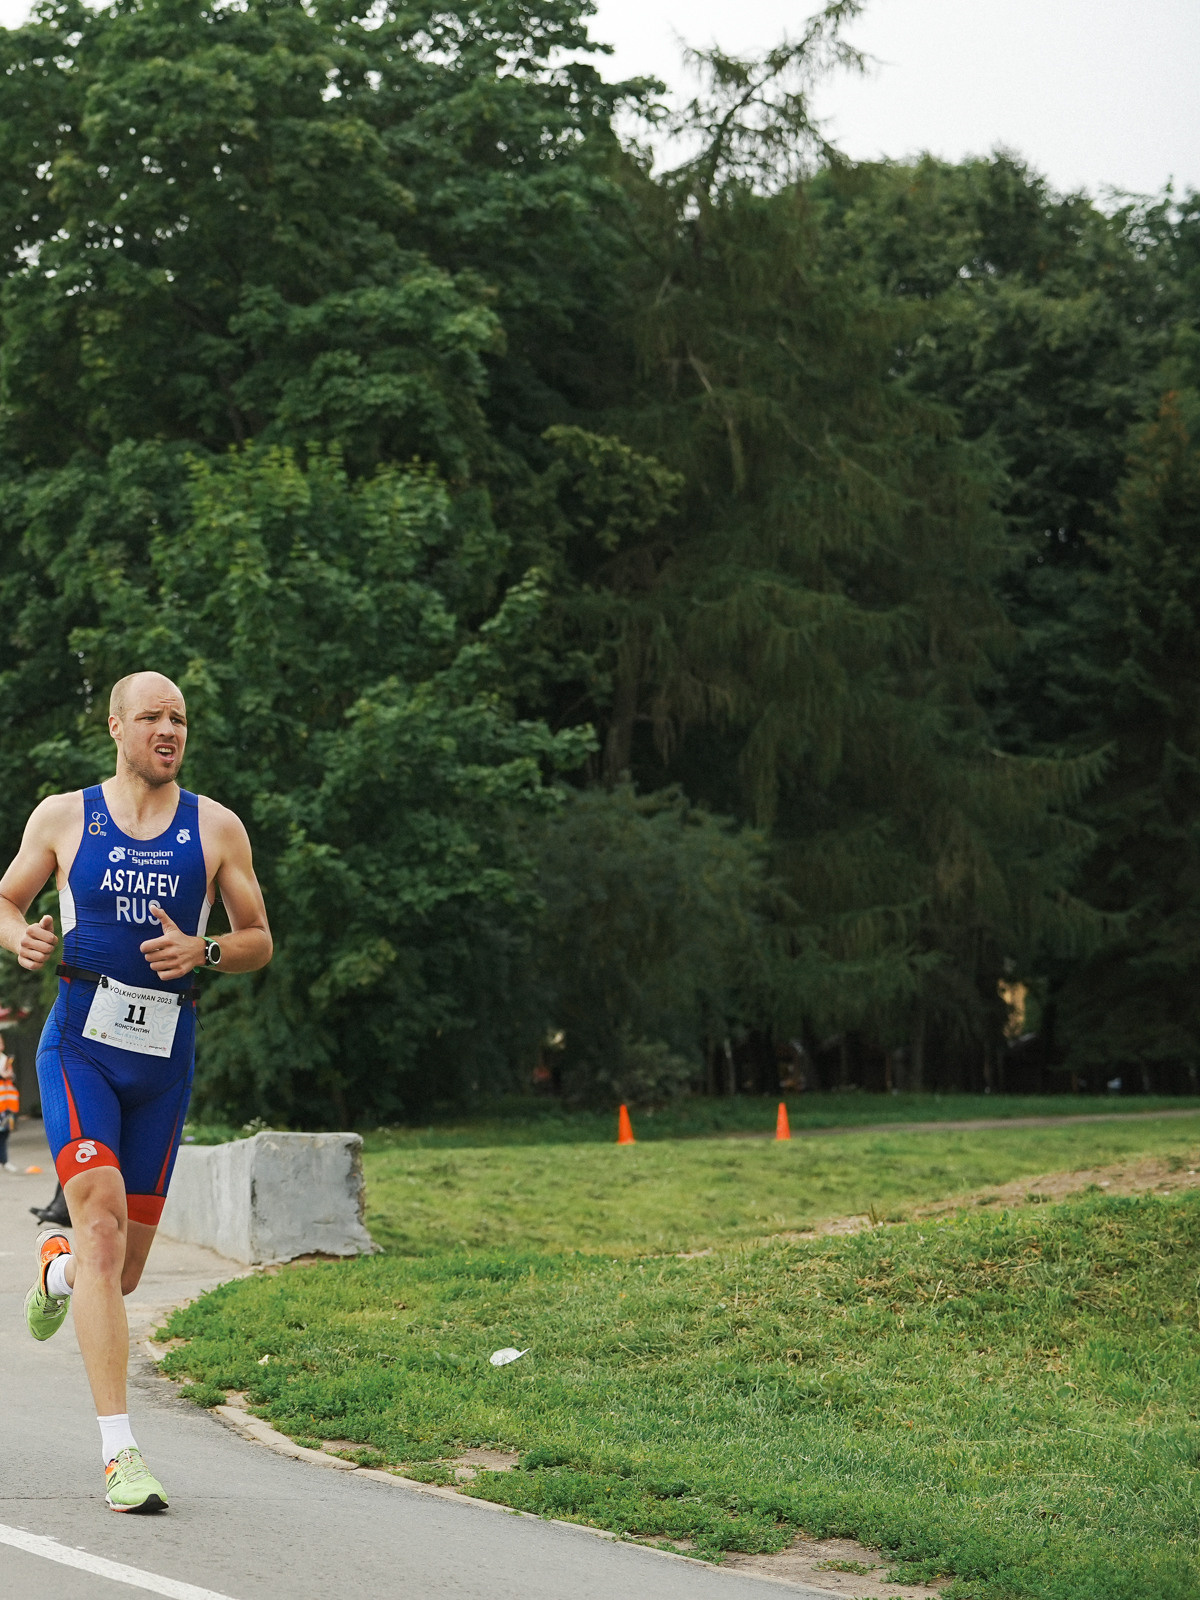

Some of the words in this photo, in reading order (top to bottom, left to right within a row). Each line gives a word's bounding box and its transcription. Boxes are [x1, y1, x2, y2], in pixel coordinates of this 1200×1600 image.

[127, 848, 174, 858] Champion
[131, 857, 169, 866] System
[100, 868, 180, 897] ASTAFEV
[116, 896, 161, 925] RUS
[110, 985, 156, 1001] VOLKHOVMAN
[156, 996, 172, 1005] 2023
[124, 1004, 146, 1025] 11
[114, 1022, 150, 1034] КОНСТАНТИН
